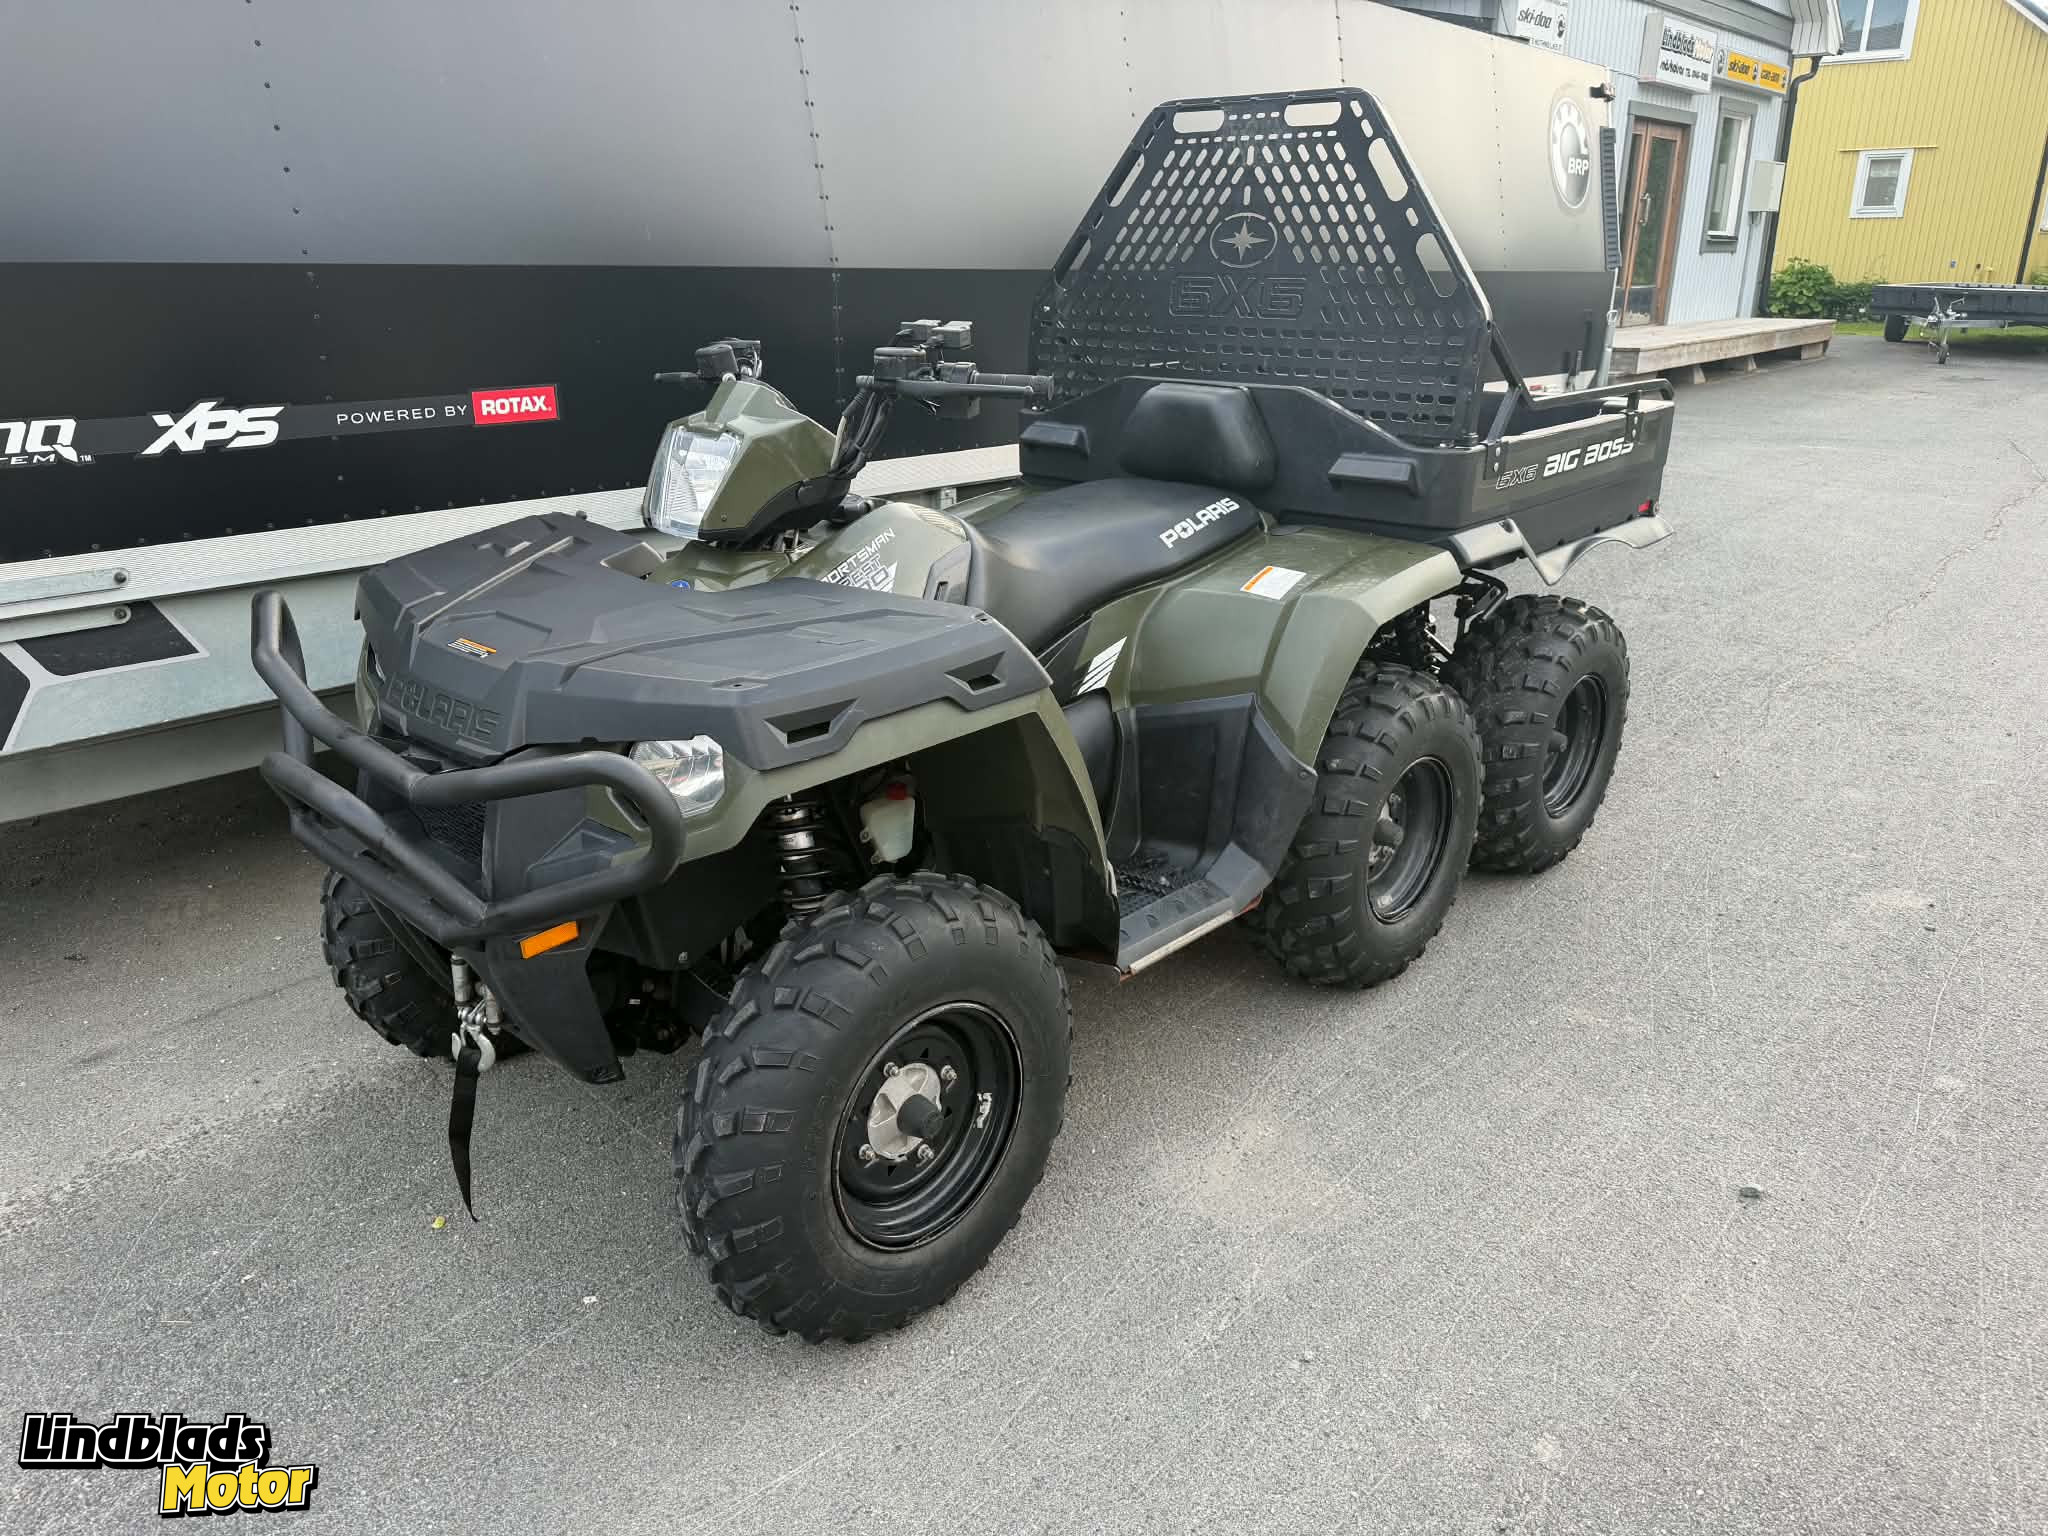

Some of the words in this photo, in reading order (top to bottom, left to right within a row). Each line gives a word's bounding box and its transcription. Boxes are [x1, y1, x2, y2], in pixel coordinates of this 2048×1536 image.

[1568, 157, 1589, 176] BRP
[337, 407, 436, 424] POWERED
[445, 404, 468, 417] BY
[481, 396, 548, 416] ROTAX
[141, 401, 285, 454] XPS
[1543, 448, 1582, 477] BIG
[1159, 497, 1240, 549] POLARIS
